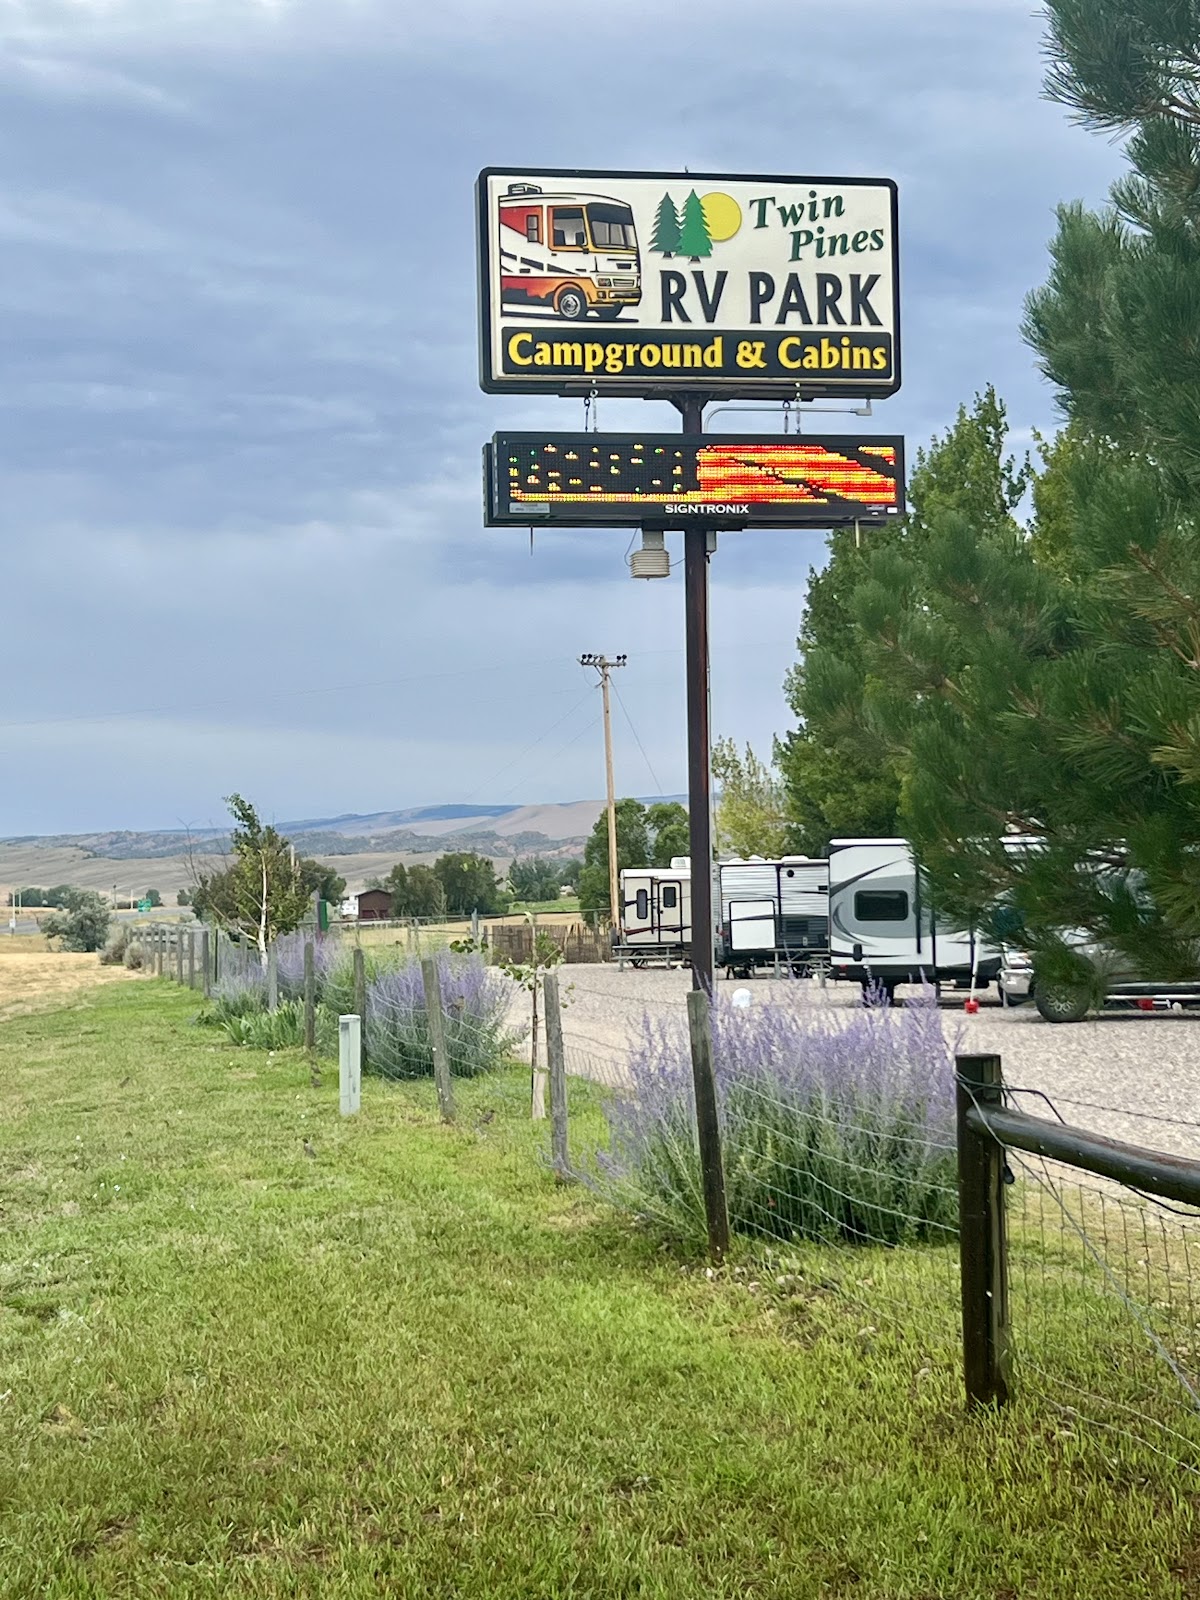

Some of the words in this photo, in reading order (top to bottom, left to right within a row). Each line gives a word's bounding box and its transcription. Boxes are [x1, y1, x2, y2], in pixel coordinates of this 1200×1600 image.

[749, 190, 844, 228] Twin
[788, 227, 885, 262] Pines
[659, 269, 728, 323] RV
[748, 270, 883, 326] PARK
[507, 332, 723, 372] Campground
[736, 341, 767, 367] &
[777, 336, 887, 370] Cabins
[664, 503, 749, 515] SIGNTRONIX
